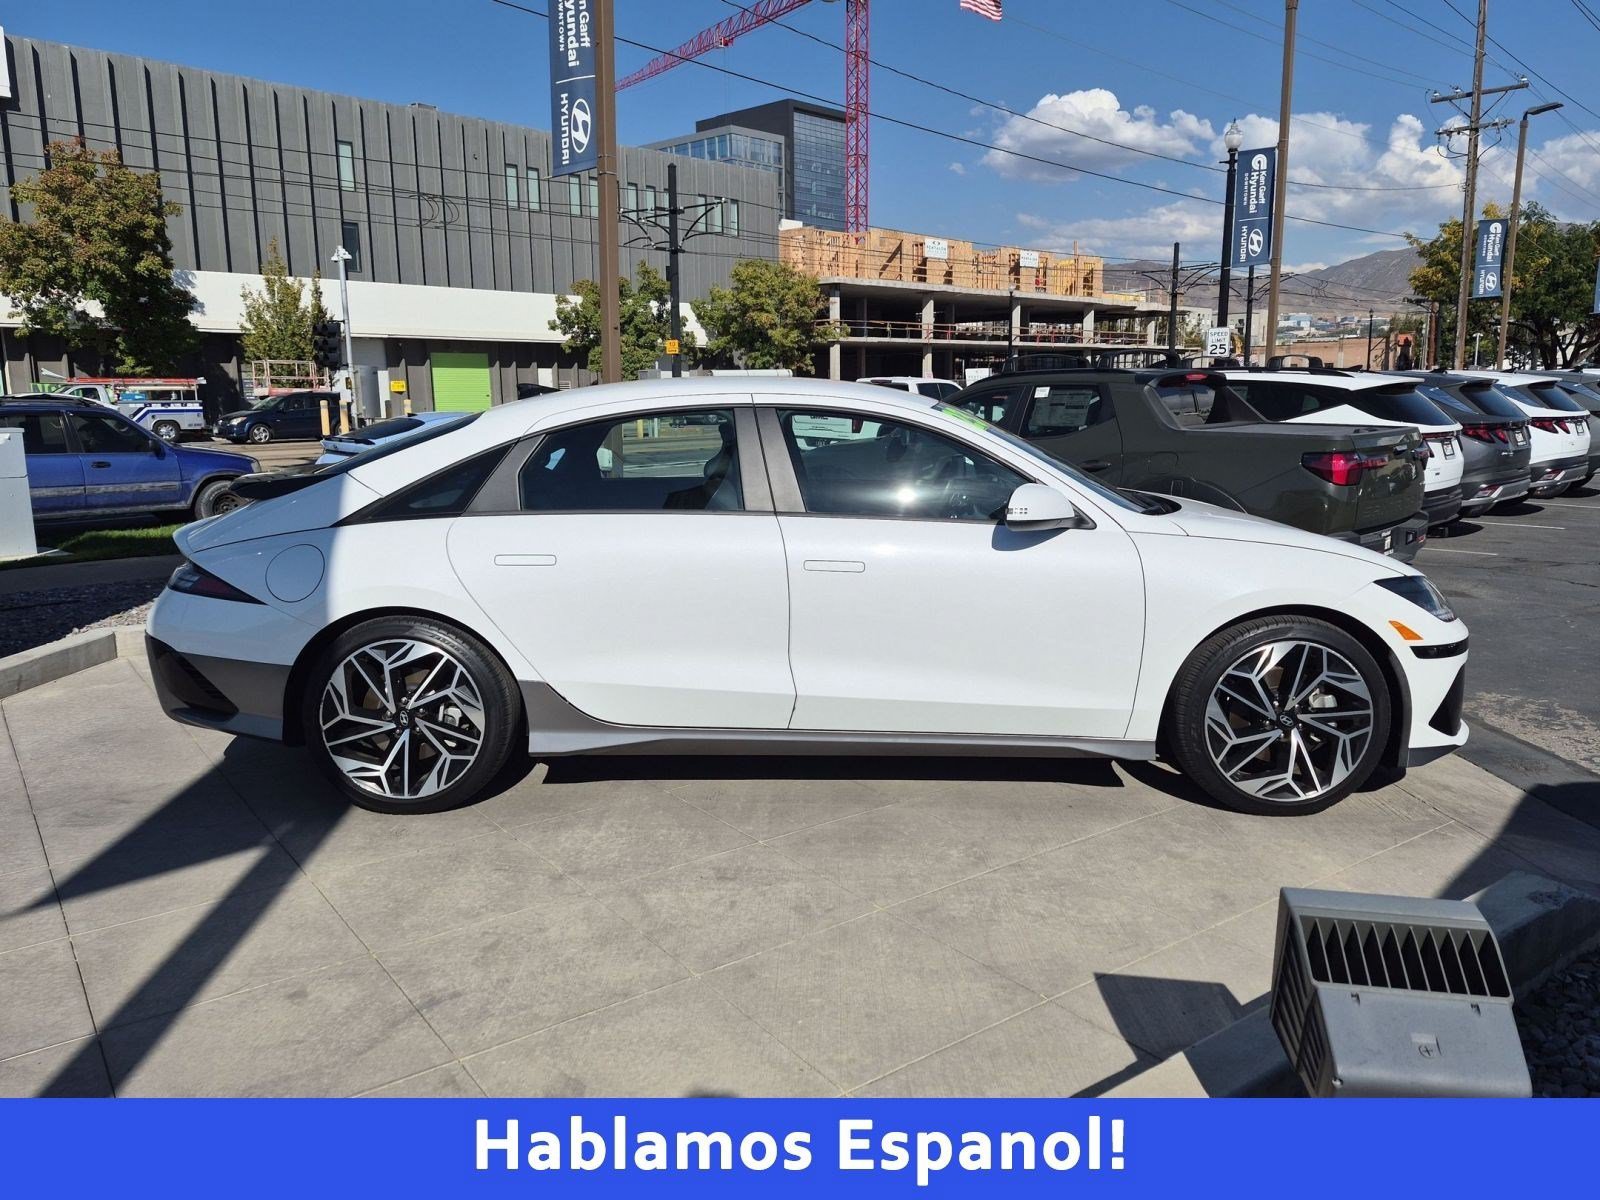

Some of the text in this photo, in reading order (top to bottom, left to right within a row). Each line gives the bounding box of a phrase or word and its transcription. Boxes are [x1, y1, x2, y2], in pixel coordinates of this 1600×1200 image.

[580, 11, 591, 47] Garff
[560, 93, 570, 165] HYUNDAI
[1249, 172, 1259, 214] Hyundai
[1210, 344, 1226, 354] 25
